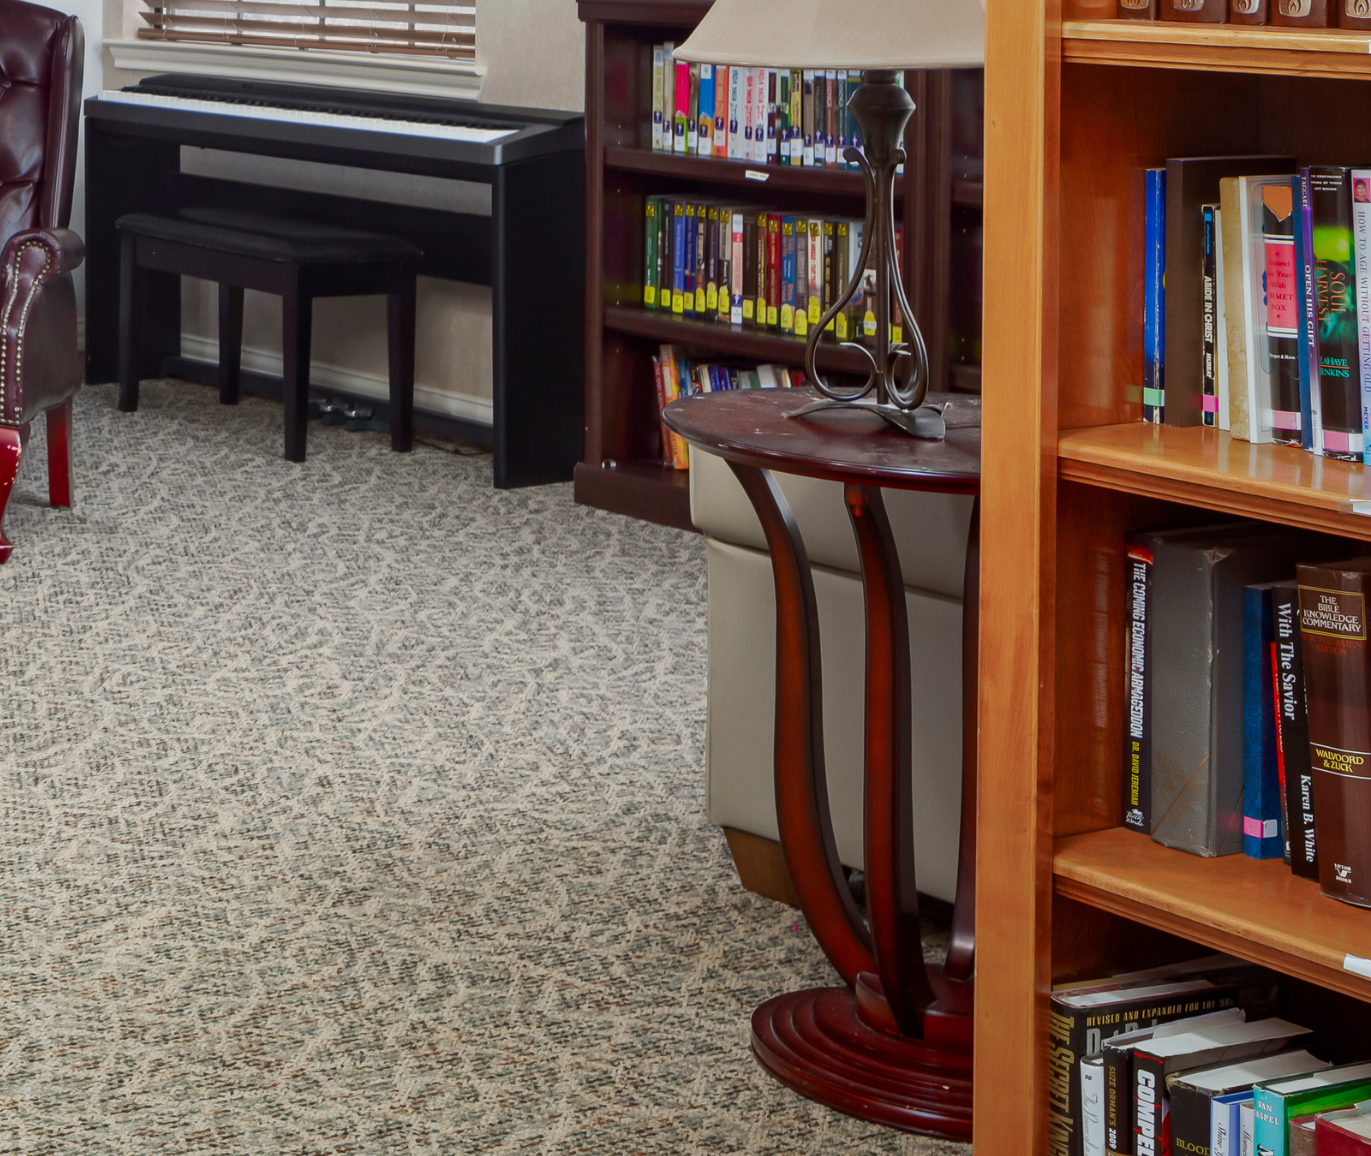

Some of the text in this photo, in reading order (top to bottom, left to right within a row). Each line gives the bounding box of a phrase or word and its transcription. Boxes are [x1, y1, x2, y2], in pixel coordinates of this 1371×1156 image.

[1301, 176, 1309, 208] TAGGART
[1304, 264, 1315, 347] OPEN HIS GIFT
[1315, 260, 1331, 325] HARVEST
[1329, 272, 1346, 313] SOUL
[1357, 211, 1371, 394] HOW TO AGE WITHOUT GETTING OLD
[1203, 275, 1213, 378] ABIDE IN CHRIST MURRAY
[1317, 603, 1341, 615] BIBLE
[1319, 595, 1337, 606] THE
[1277, 602, 1293, 638] With
[1302, 616, 1362, 634] COMMENTARY
[1303, 609, 1360, 625] KNOWLEDGE
[1130, 562, 1147, 738] THE COMING ECONOMIC ARMAGEDDON
[1280, 642, 1295, 670] The
[1282, 673, 1297, 721] Savior
[1131, 740, 1141, 753] DR.
[1315, 748, 1365, 766] WALVOORD
[1131, 754, 1141, 773] DAVID
[1323, 758, 1354, 774] & ZUCK
[1131, 774, 1140, 806] JEREMIAH
[1300, 774, 1315, 864] Karen B. White
[1049, 1010, 1075, 1046] THE
[1086, 1000, 1217, 1027] REVISED AND EXPANDED FOR THE
[1108, 1065, 1117, 1150] SUZE ORMAN'S 2009
[1257, 1100, 1273, 1114] VAN
